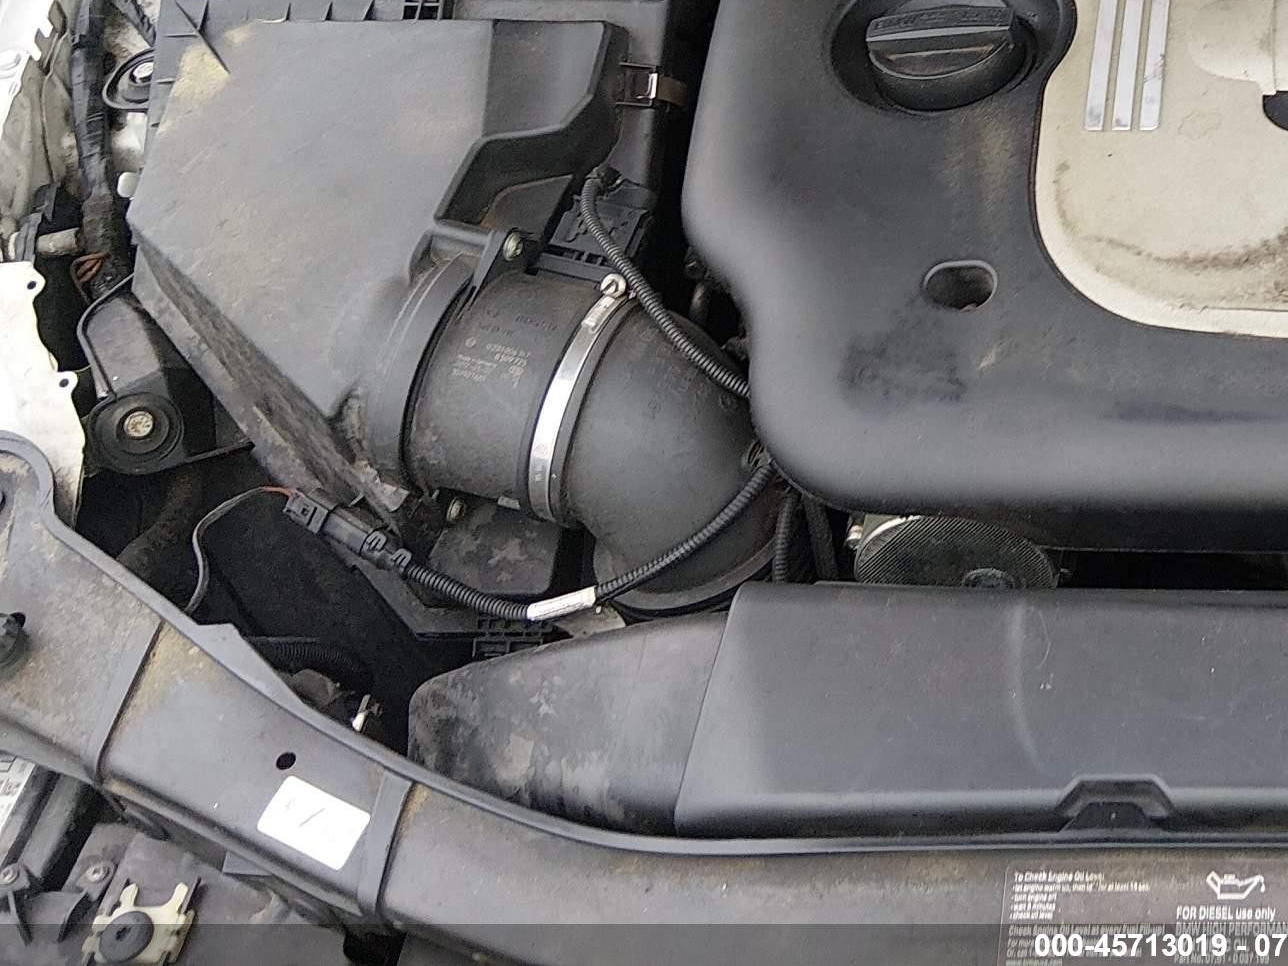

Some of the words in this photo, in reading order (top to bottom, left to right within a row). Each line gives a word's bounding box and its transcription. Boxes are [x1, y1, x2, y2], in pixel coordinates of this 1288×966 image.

[1024, 870, 1047, 883] Check
[1048, 870, 1073, 883] Engine
[1074, 870, 1085, 882] Oil
[1176, 905, 1197, 921] FOR
[1199, 905, 1234, 921] DIESEL
[1235, 907, 1253, 920] use
[1254, 906, 1276, 922] only
[1175, 922, 1201, 936] BMW
[1203, 922, 1227, 936] HIGH
